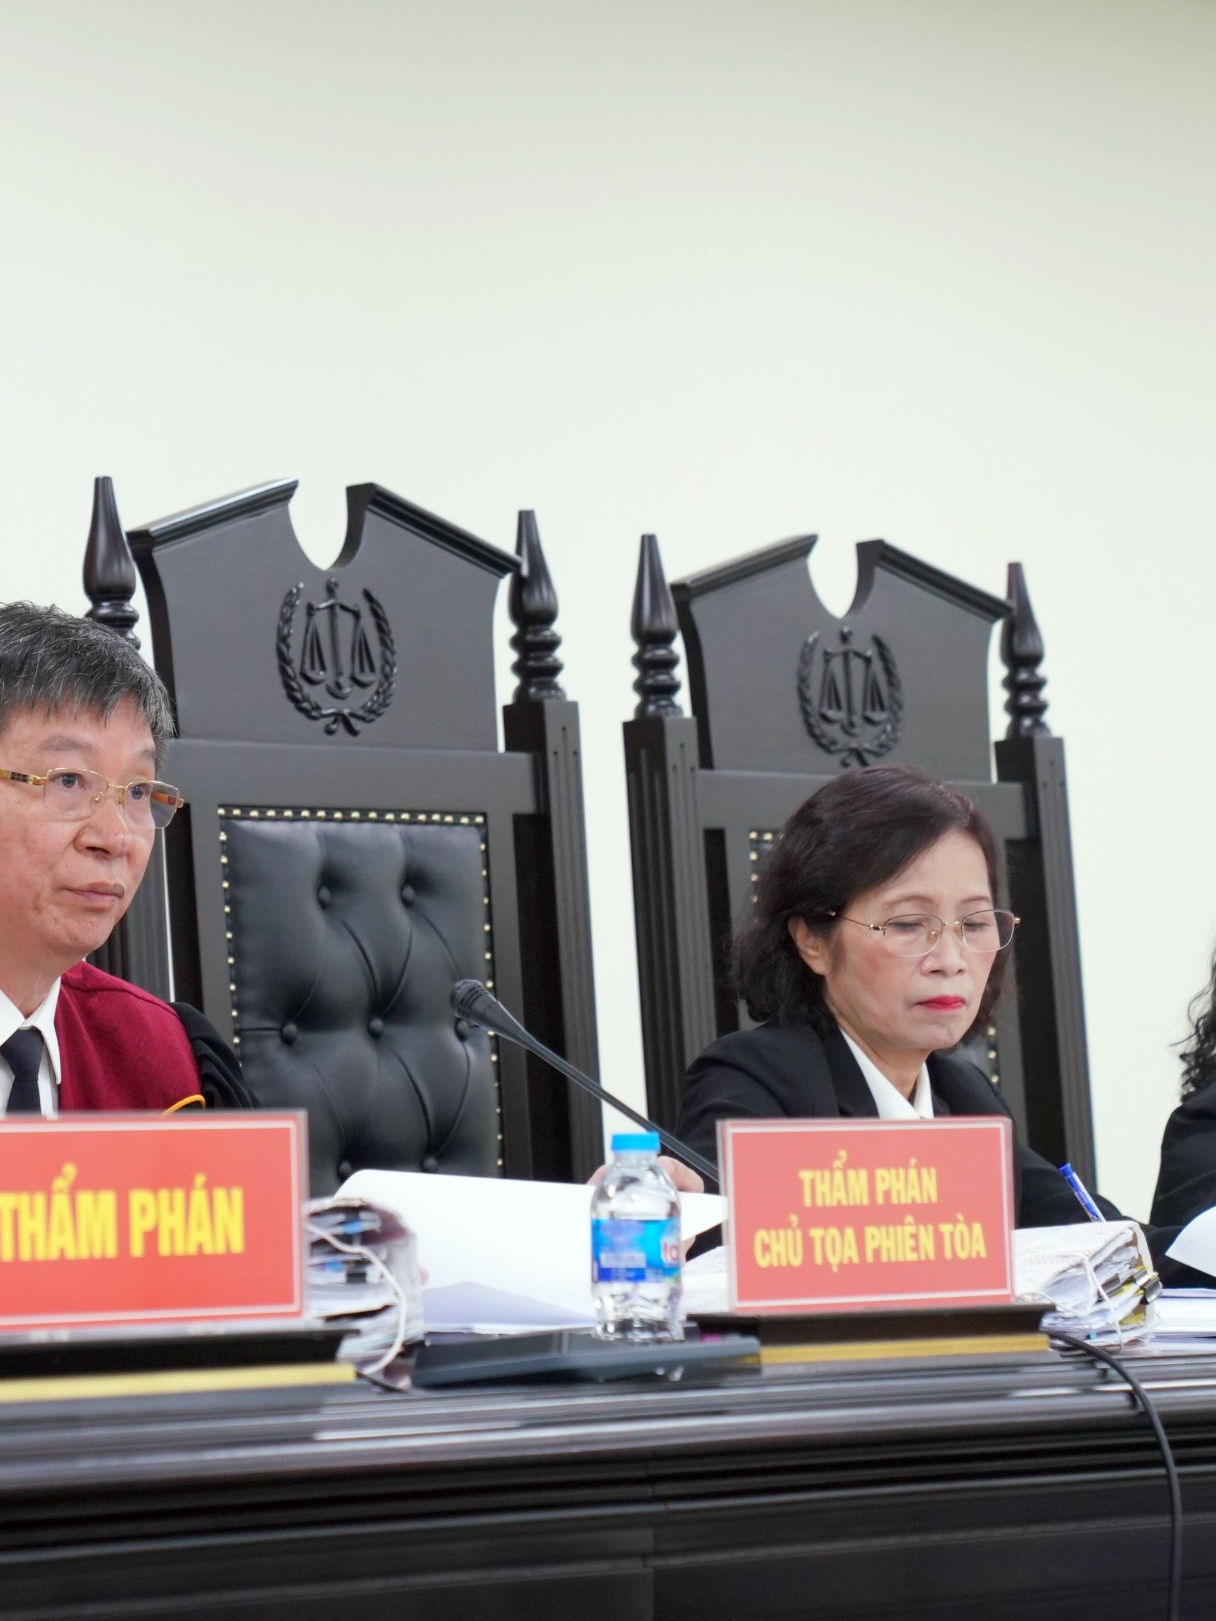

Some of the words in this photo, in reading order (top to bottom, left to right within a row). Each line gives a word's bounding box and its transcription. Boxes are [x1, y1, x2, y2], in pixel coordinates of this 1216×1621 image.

[798, 1149, 869, 1207] THẨM
[875, 1157, 938, 1205] PHÁN
[129, 1172, 244, 1258] PHÁN
[754, 1213, 804, 1268] CHỦ
[808, 1226, 860, 1273] TỌA
[865, 1214, 935, 1263] PHIÊN
[939, 1212, 987, 1260] TÒA
